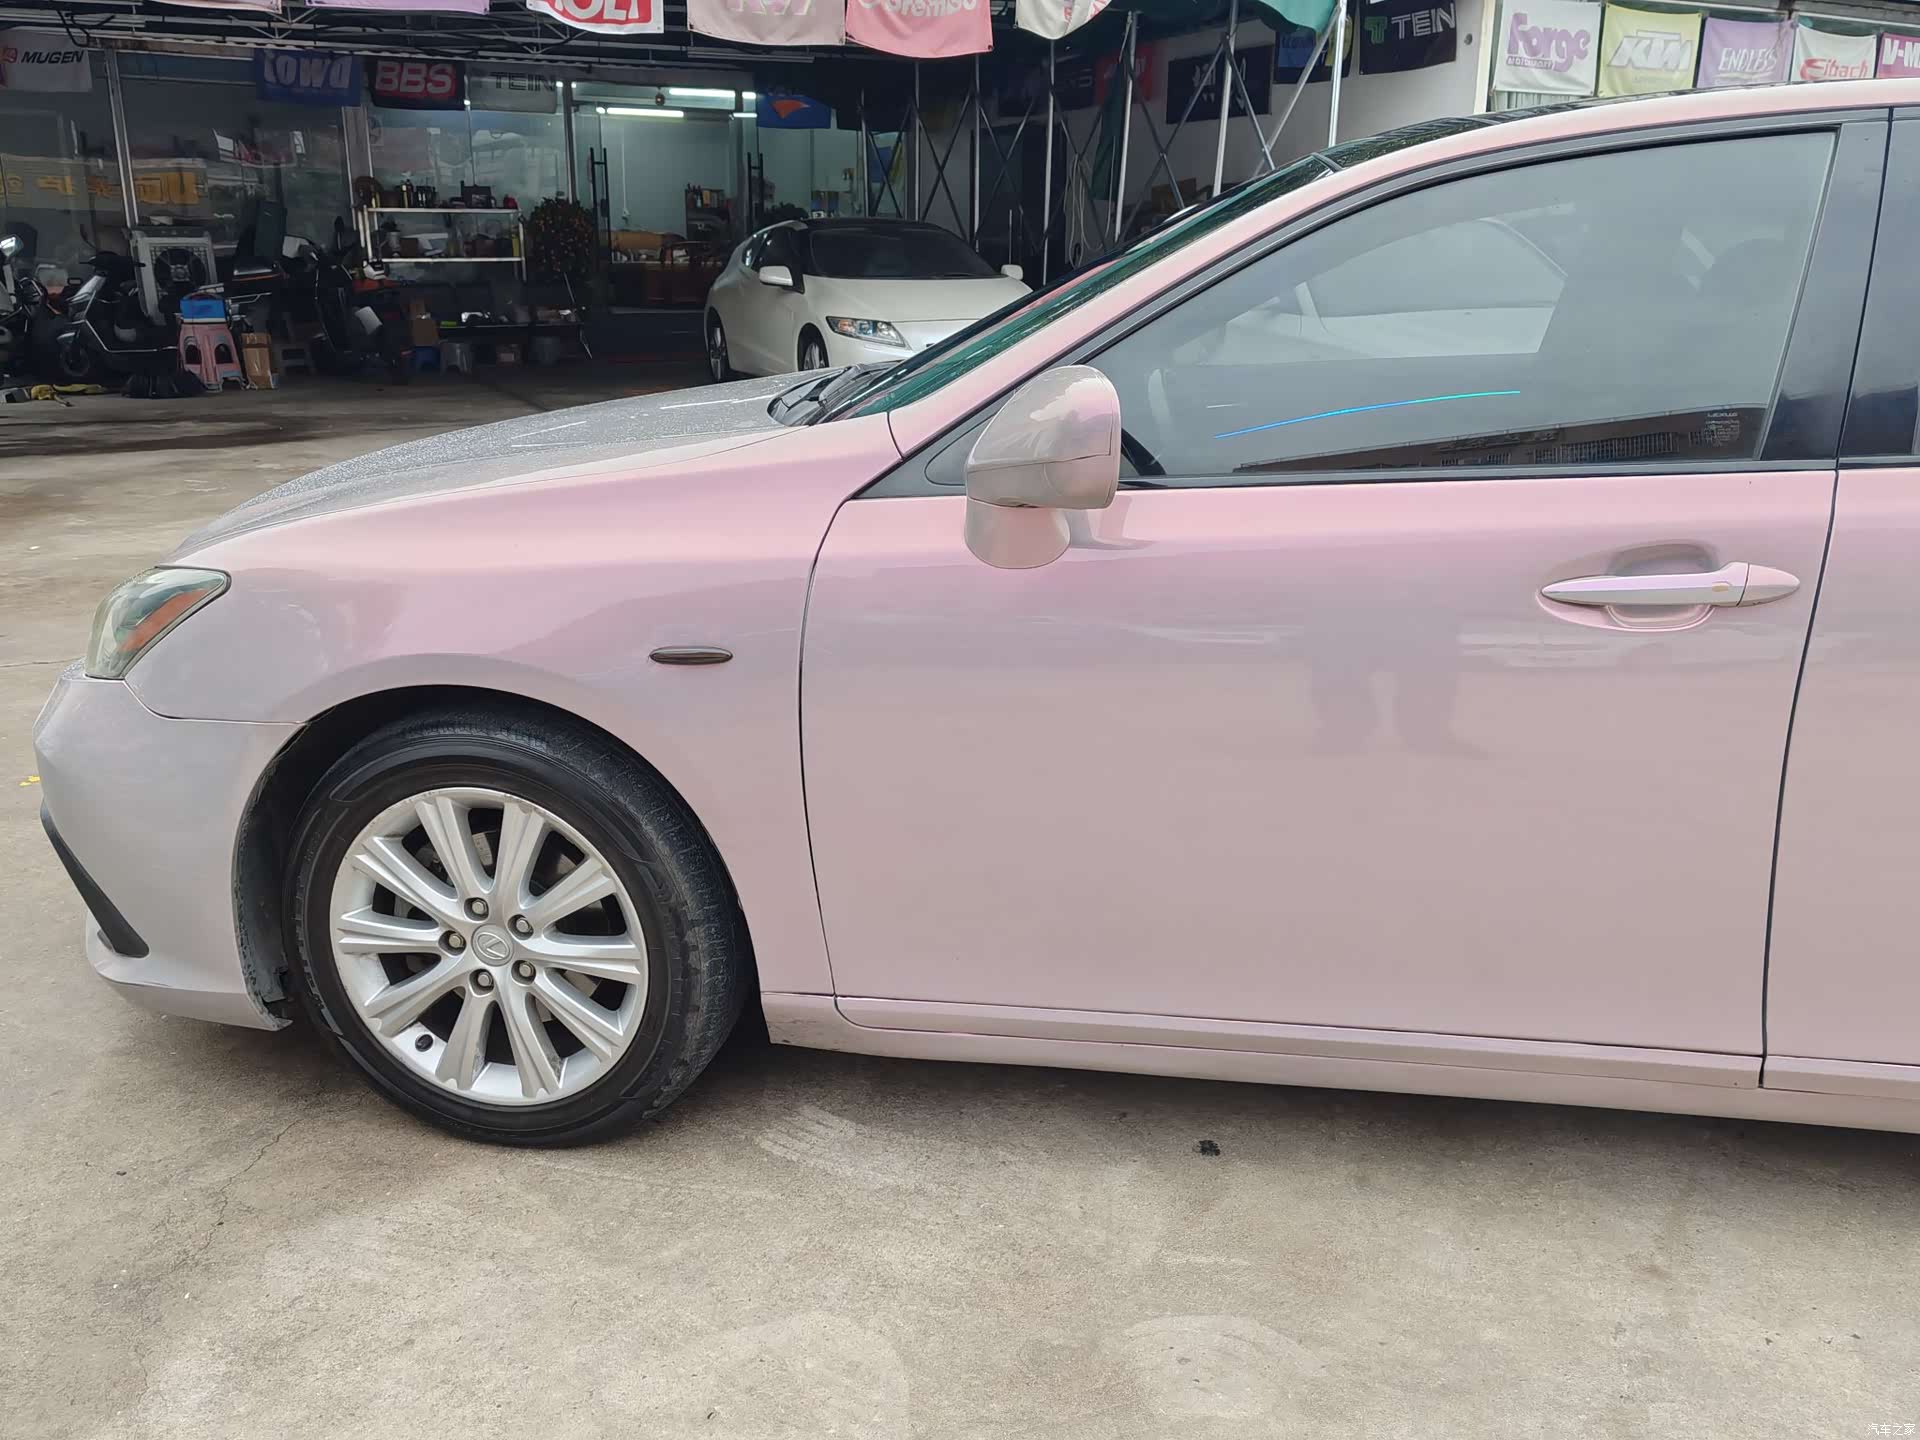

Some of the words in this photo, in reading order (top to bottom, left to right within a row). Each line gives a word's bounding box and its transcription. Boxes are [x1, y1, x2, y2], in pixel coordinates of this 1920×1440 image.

[1391, 3, 1455, 40] TEIN
[20, 50, 84, 64] MUGEN
[1507, 12, 1591, 72] Forge
[1607, 30, 1691, 71] KTM
[1718, 47, 1777, 72] ENDLESS
[1800, 58, 1868, 80] Eibach
[375, 60, 453, 94] BBS
